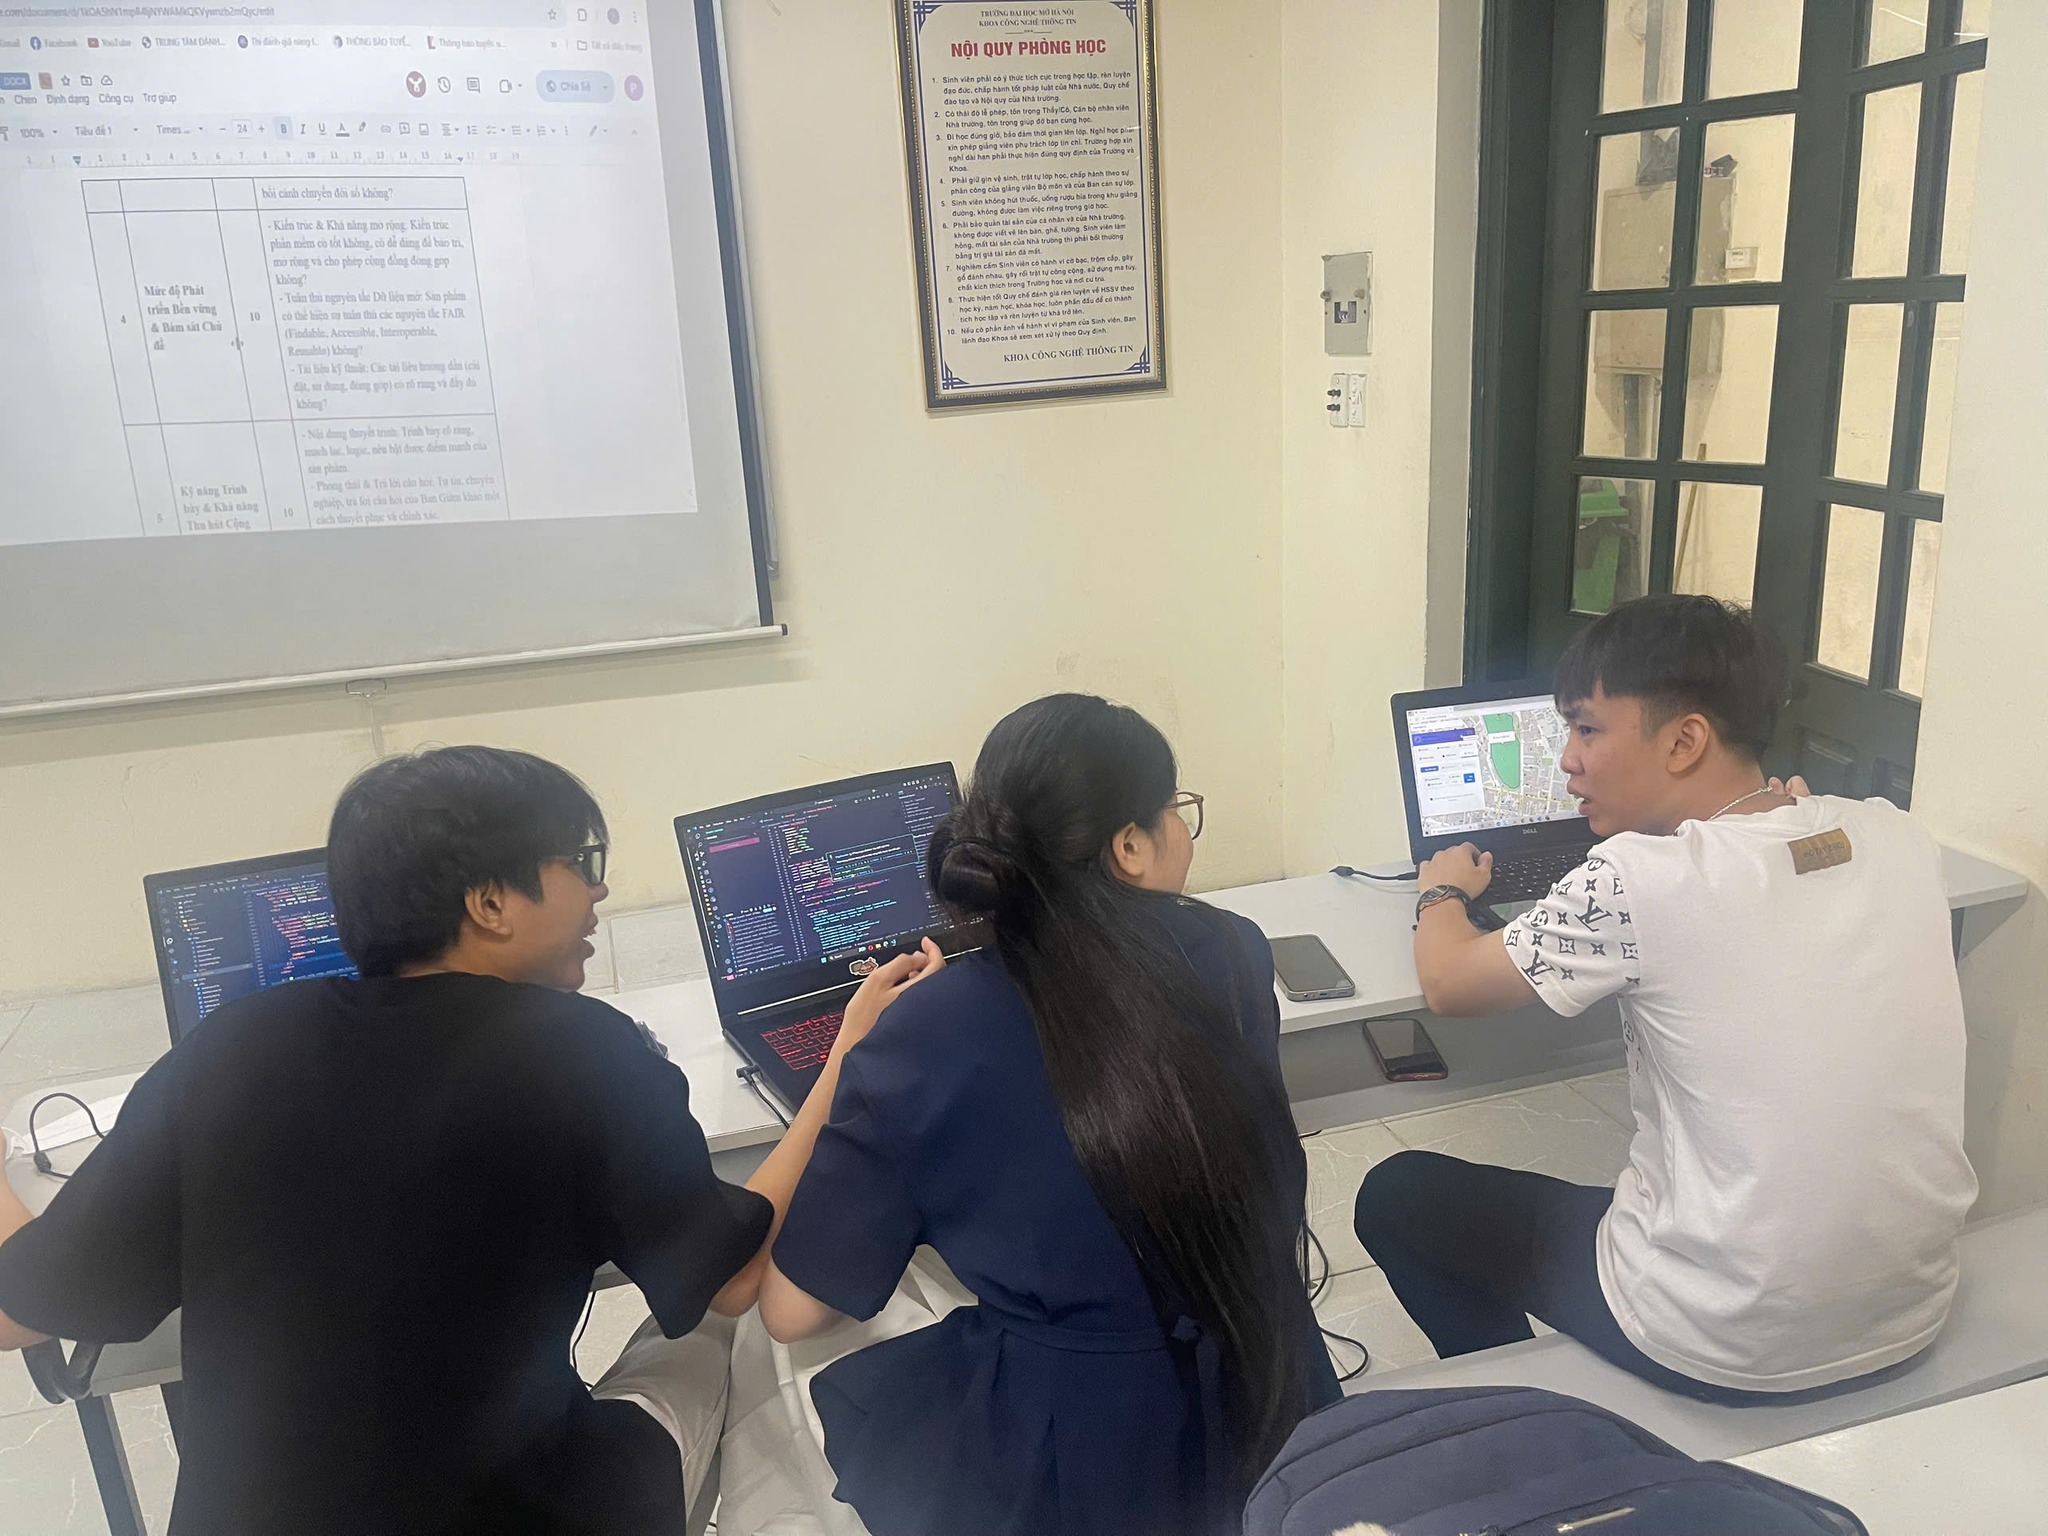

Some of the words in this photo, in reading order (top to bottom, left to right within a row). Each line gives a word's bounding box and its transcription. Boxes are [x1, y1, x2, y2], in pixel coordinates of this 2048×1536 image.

[951, 40, 978, 59] NỘI
[983, 42, 1013, 57] QUY
[1019, 38, 1070, 55] PHÒNG
[1075, 39, 1106, 56] HỌC
[237, 125, 248, 134] 24
[250, 312, 261, 321] 10
[442, 308, 465, 319] FAIR
[1004, 354, 1029, 362] KHOA
[1031, 350, 1056, 360] CÔNG
[1058, 348, 1084, 358] NGHỆ
[1086, 346, 1116, 356] THÔNG
[1118, 345, 1134, 353] TIN
[284, 508, 294, 517] 10
